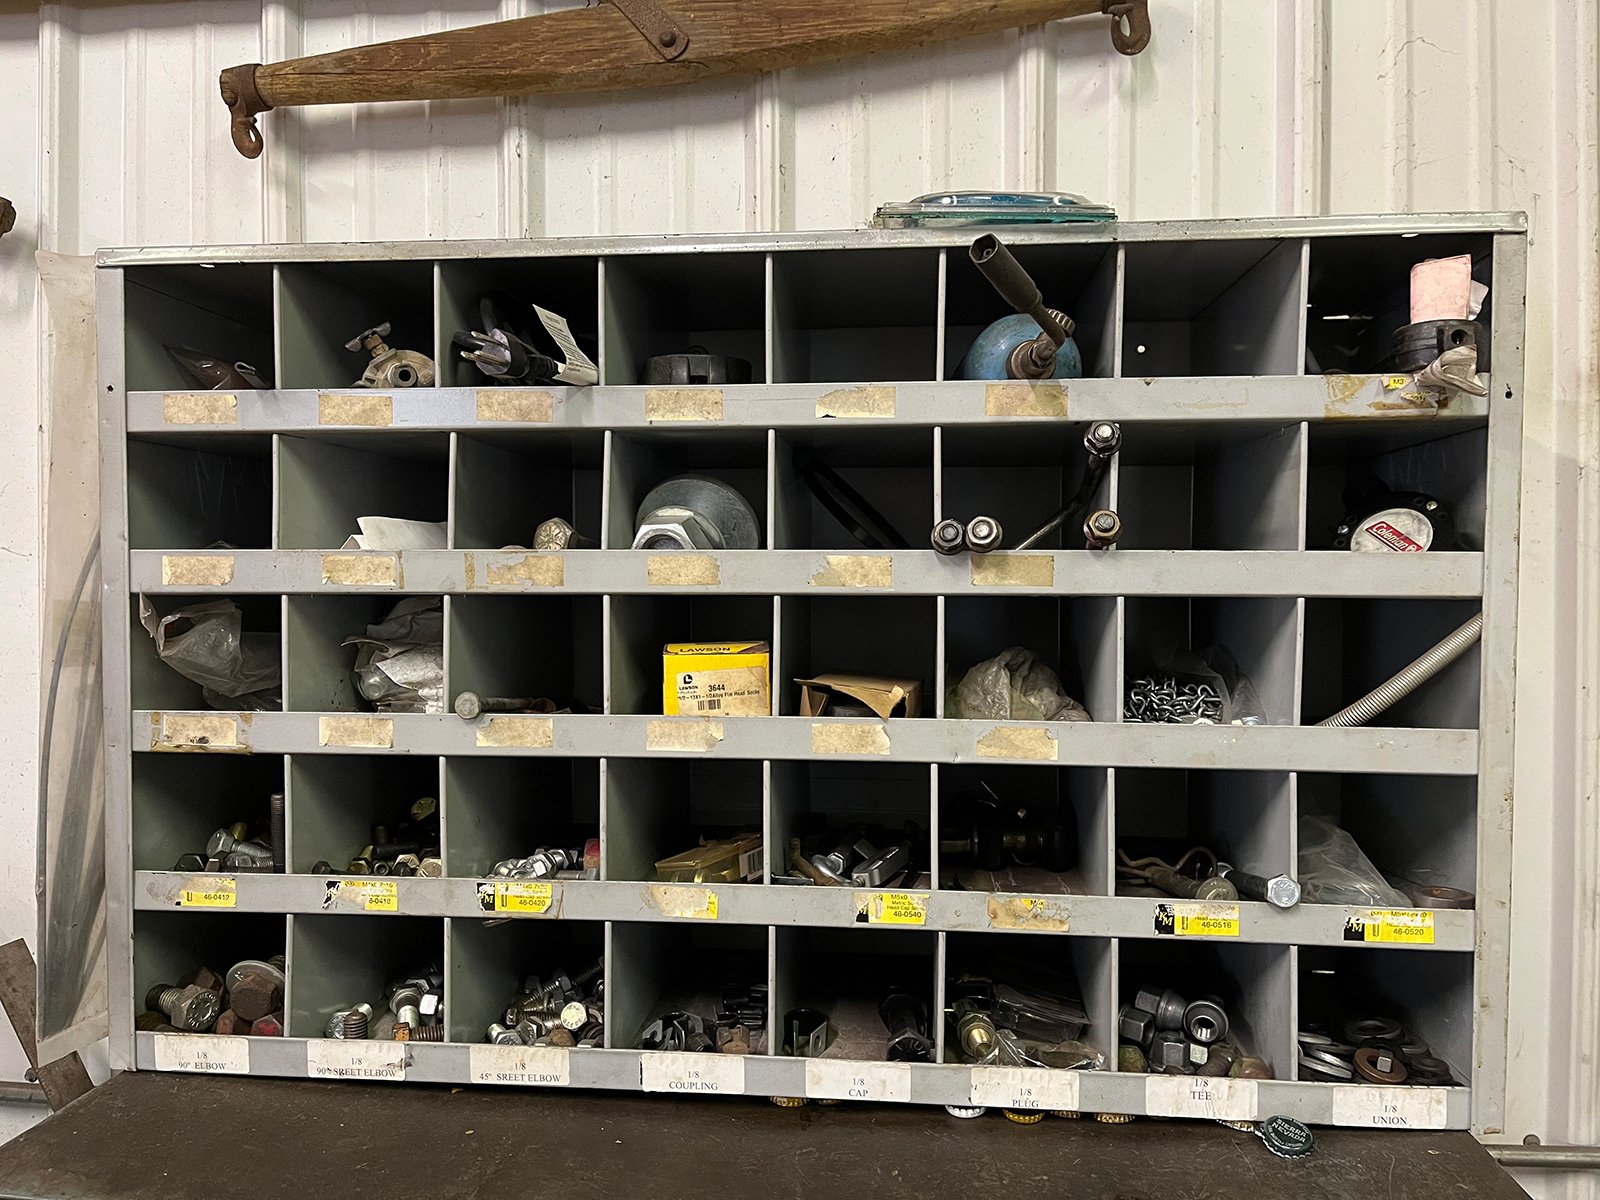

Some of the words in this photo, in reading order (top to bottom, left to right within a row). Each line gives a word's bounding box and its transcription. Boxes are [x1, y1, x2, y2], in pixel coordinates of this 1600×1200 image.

[1372, 523, 1409, 549] Coleman
[708, 684, 726, 692] 3644
[203, 893, 230, 901] 46-0412
[518, 899, 546, 907] 46-0420
[893, 910, 922, 918] 46-0540
[1392, 928, 1425, 936] 46-0520
[196, 1051, 208, 1060] 1/8
[194, 1061, 227, 1070] ELBOW
[350, 1057, 363, 1065] 1/8
[514, 1062, 527, 1071] 1/8
[333, 1067, 362, 1076] SREET
[364, 1069, 396, 1078] ELBOW
[687, 1070, 700, 1079] 1/8
[479, 1072, 492, 1081] 45°
[496, 1072, 527, 1082] SREET
[528, 1073, 562, 1083] ELBOW
[852, 1077, 865, 1086] 1/8
[668, 1081, 719, 1091] COUPLING
[1194, 1078, 1209, 1088] 1/8
[848, 1088, 869, 1097] CAP
[1019, 1088, 1033, 1097] 1/8
[1189, 1090, 1213, 1101] TEE
[1012, 1098, 1039, 1108] PLUG
[1384, 1104, 1398, 1113] 1/8
[1372, 1115, 1408, 1125] UNION
[1271, 1121, 1307, 1143] NEVADA
[1275, 1118, 1307, 1138] SIERRA
